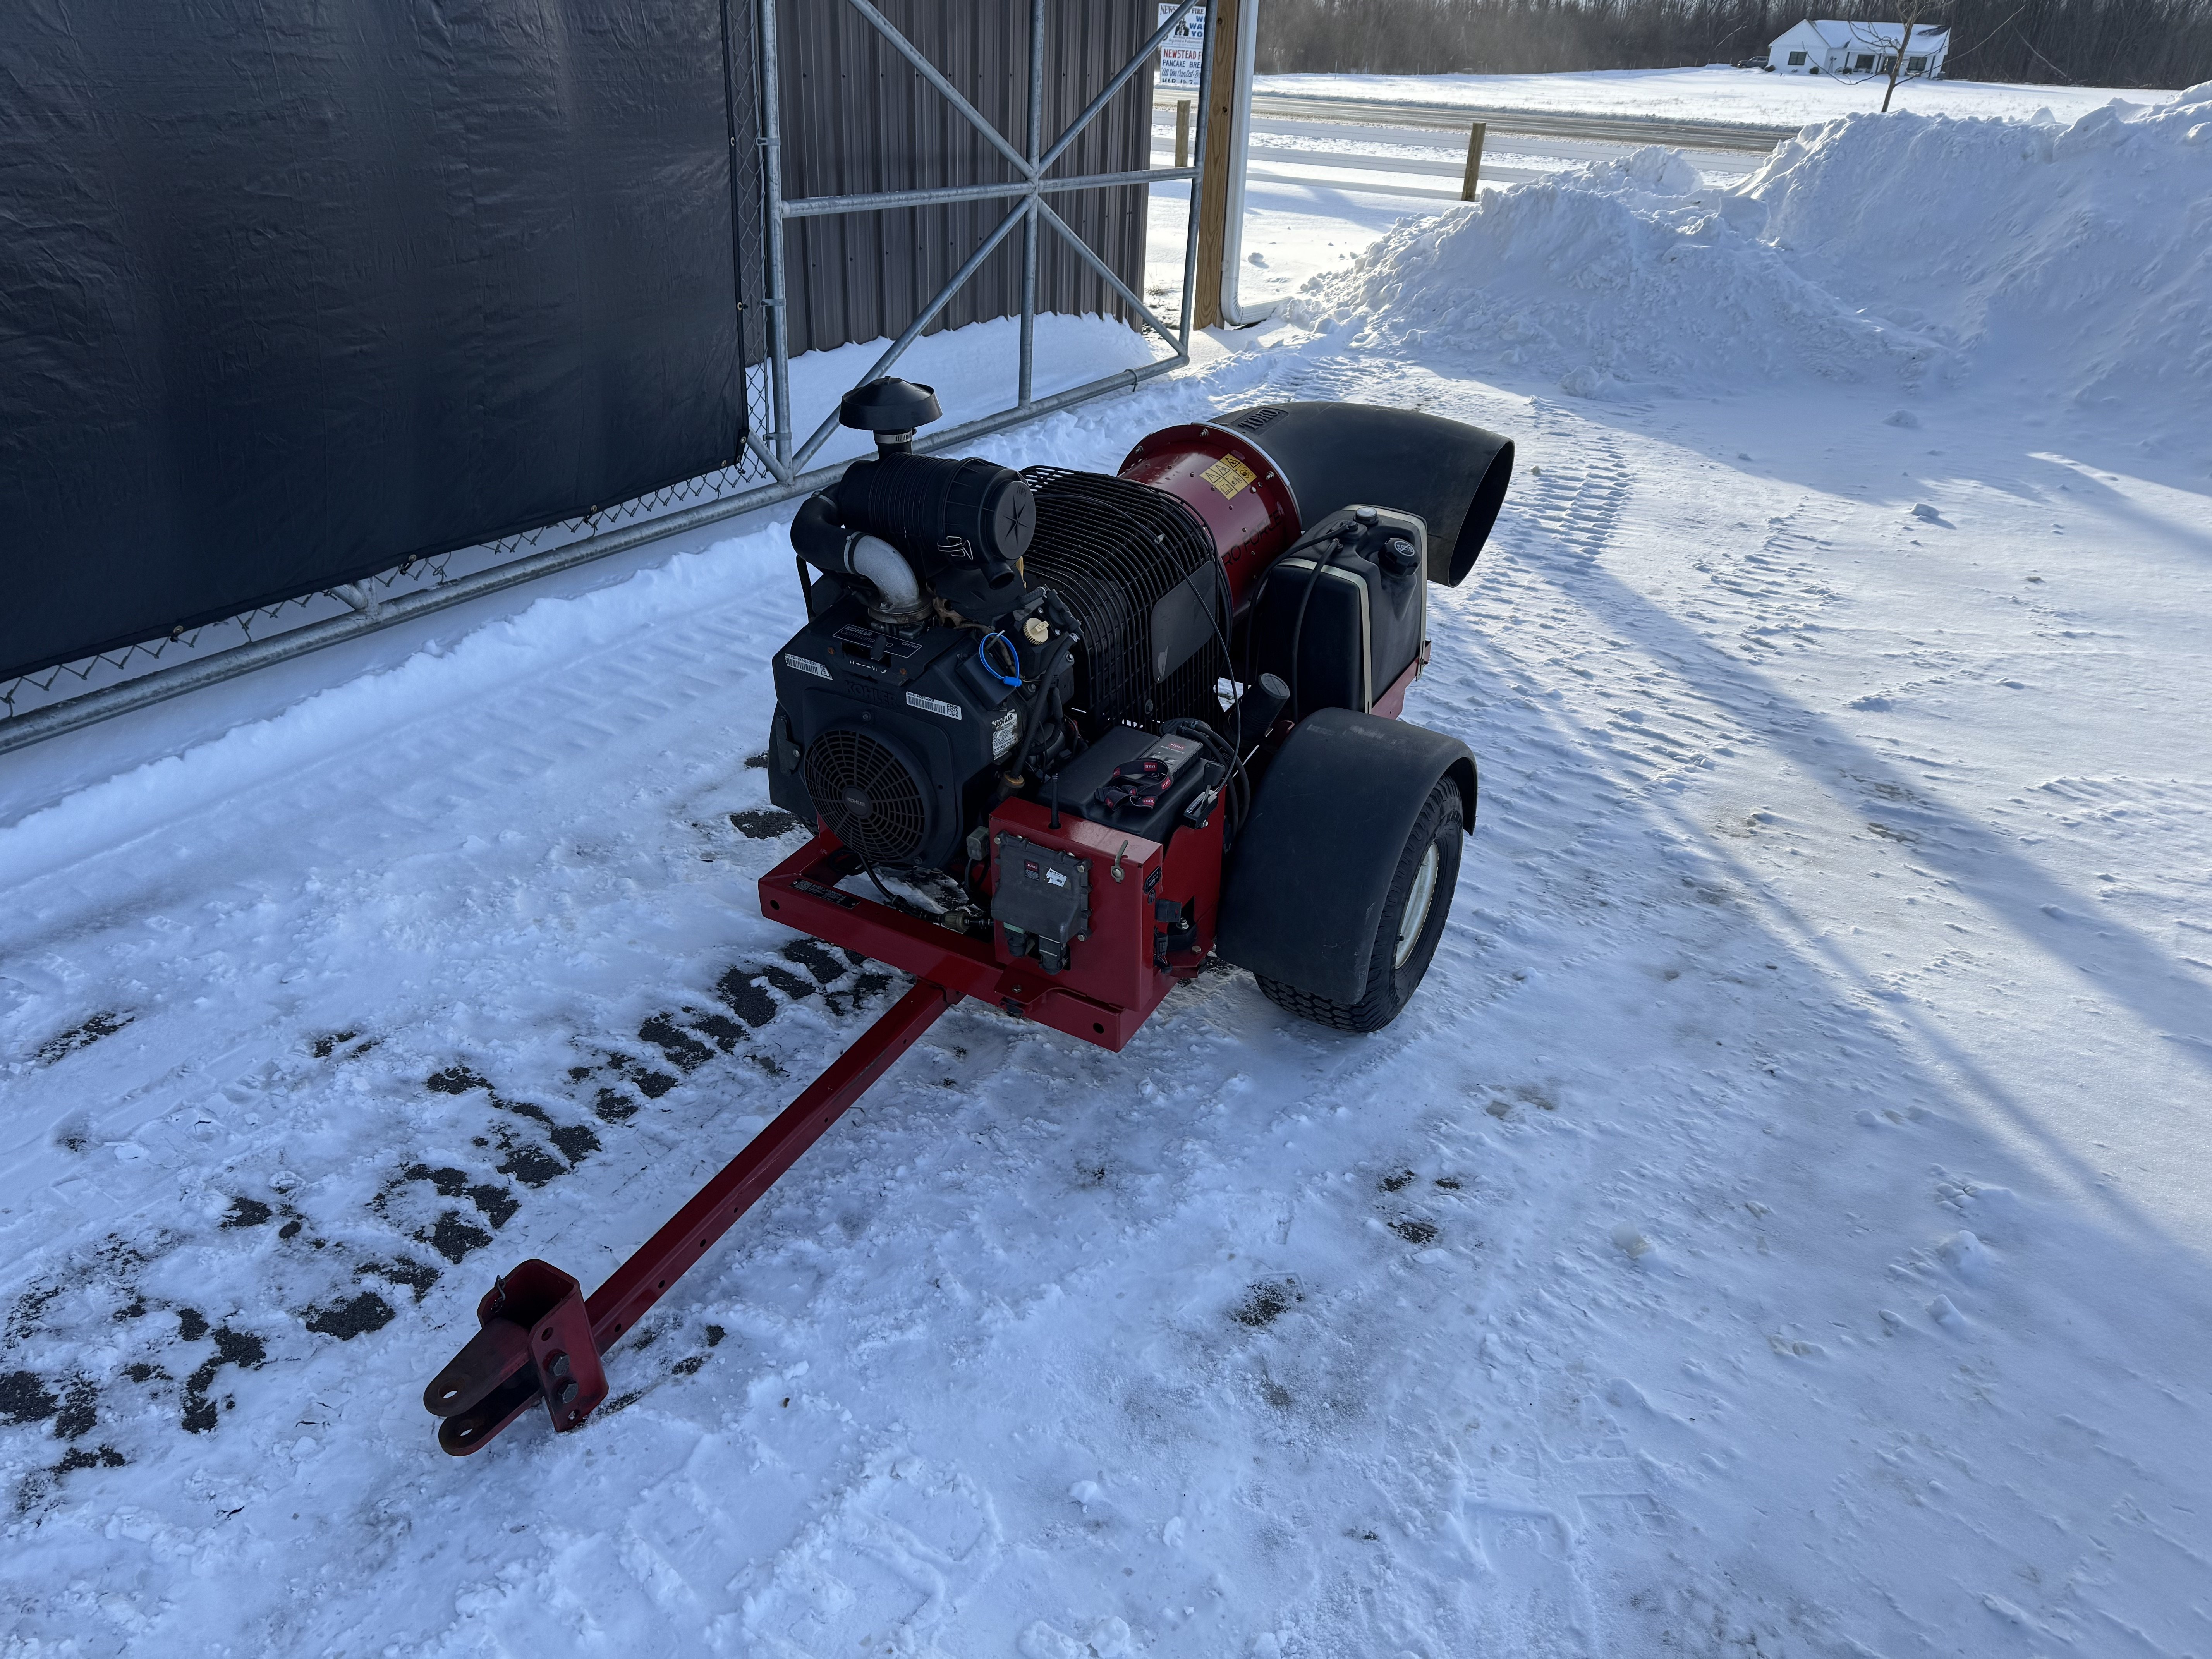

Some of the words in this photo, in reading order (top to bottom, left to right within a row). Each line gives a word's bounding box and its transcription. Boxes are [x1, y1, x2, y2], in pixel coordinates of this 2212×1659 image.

[1163, 49, 1196, 59] NEWSTEAD
[1198, 51, 1202, 60] F
[1238, 408, 1280, 430] TORO
[1221, 544, 1241, 565] RO
[1242, 510, 1282, 552] FORCE
[845, 626, 872, 637] KOHLER
[845, 680, 897, 706] KOHLER
[996, 714, 1013, 727] KOHLER
[847, 797, 866, 807] KOHLER
